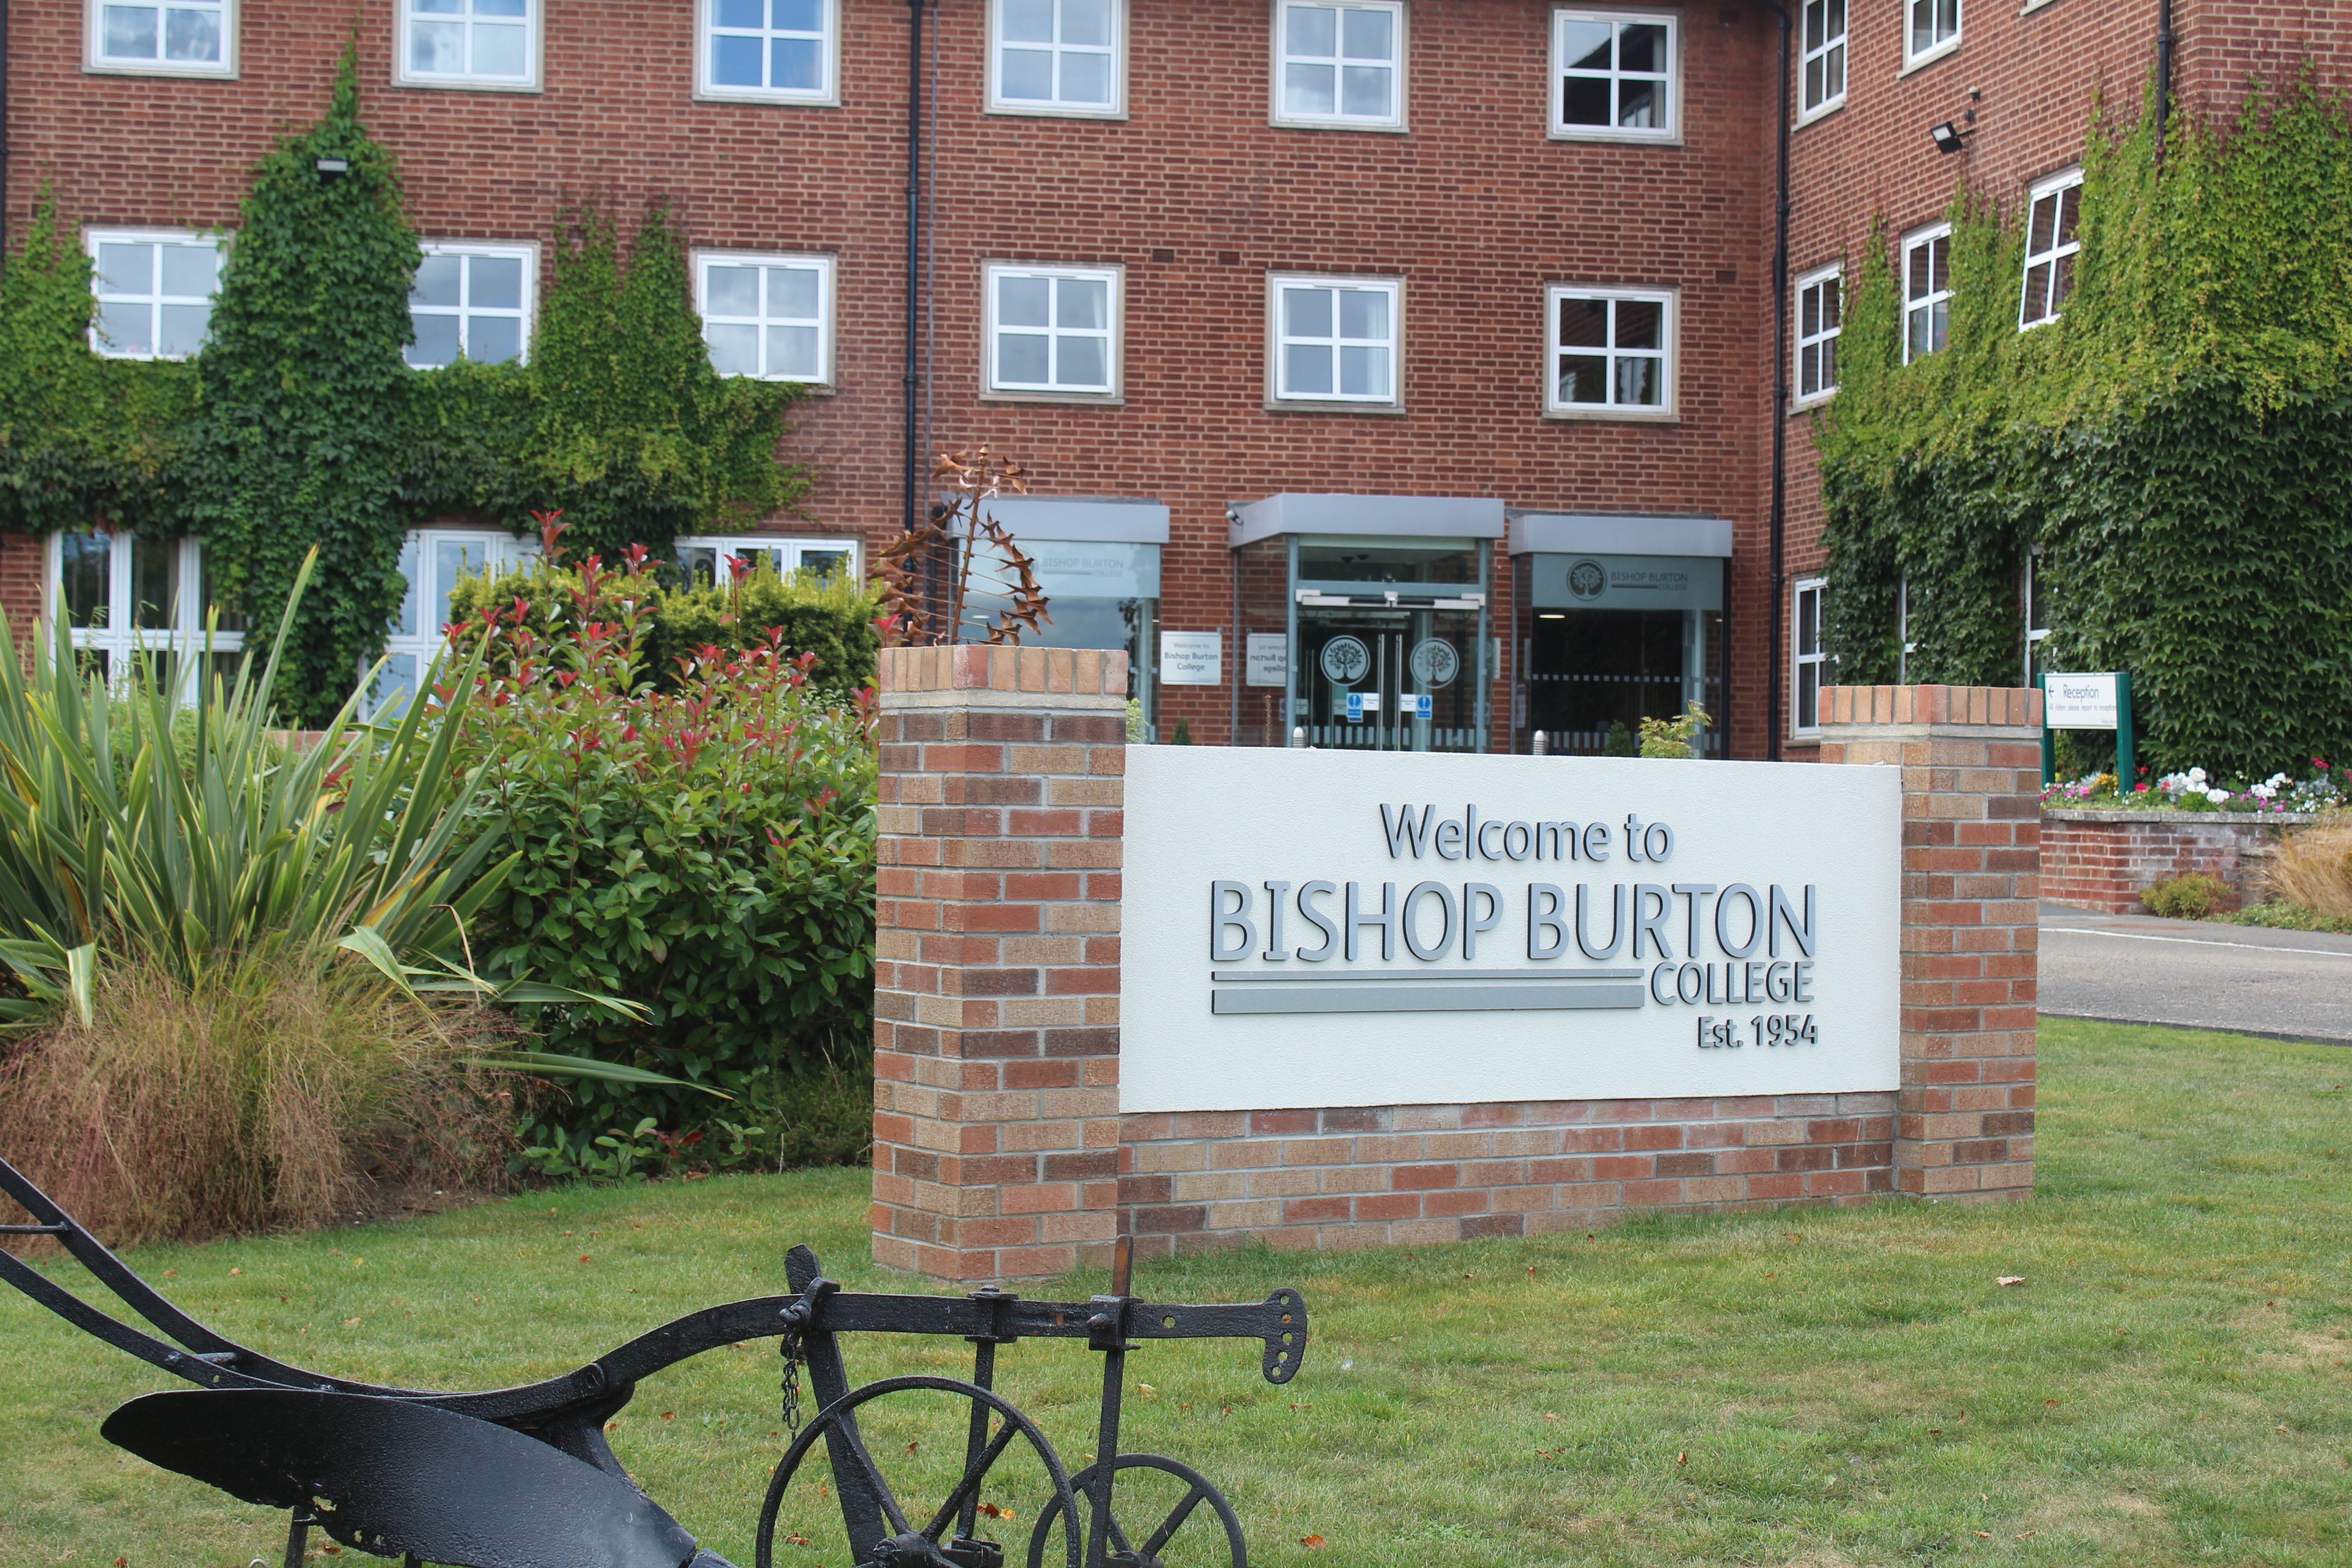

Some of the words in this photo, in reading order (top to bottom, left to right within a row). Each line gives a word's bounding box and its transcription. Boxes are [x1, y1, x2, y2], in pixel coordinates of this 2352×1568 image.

[1042, 558, 1079, 567] BISHOP
[1082, 559, 1123, 568] BURTON
[1611, 571, 1646, 581] BISHOP
[1649, 572, 1688, 582] BURTON
[1164, 652, 1190, 661] Bishop
[1177, 663, 1205, 672] College
[2063, 684, 2099, 703] Reception
[1380, 804, 1612, 861] Welcome
[1624, 813, 1674, 862] to
[1210, 880, 1504, 961] BISHOP
[1527, 882, 1815, 960] BURTON
[1651, 961, 1815, 1005] COLLEGE
[1698, 1016, 1744, 1048] Est.
[1750, 1014, 1818, 1046] 1954
